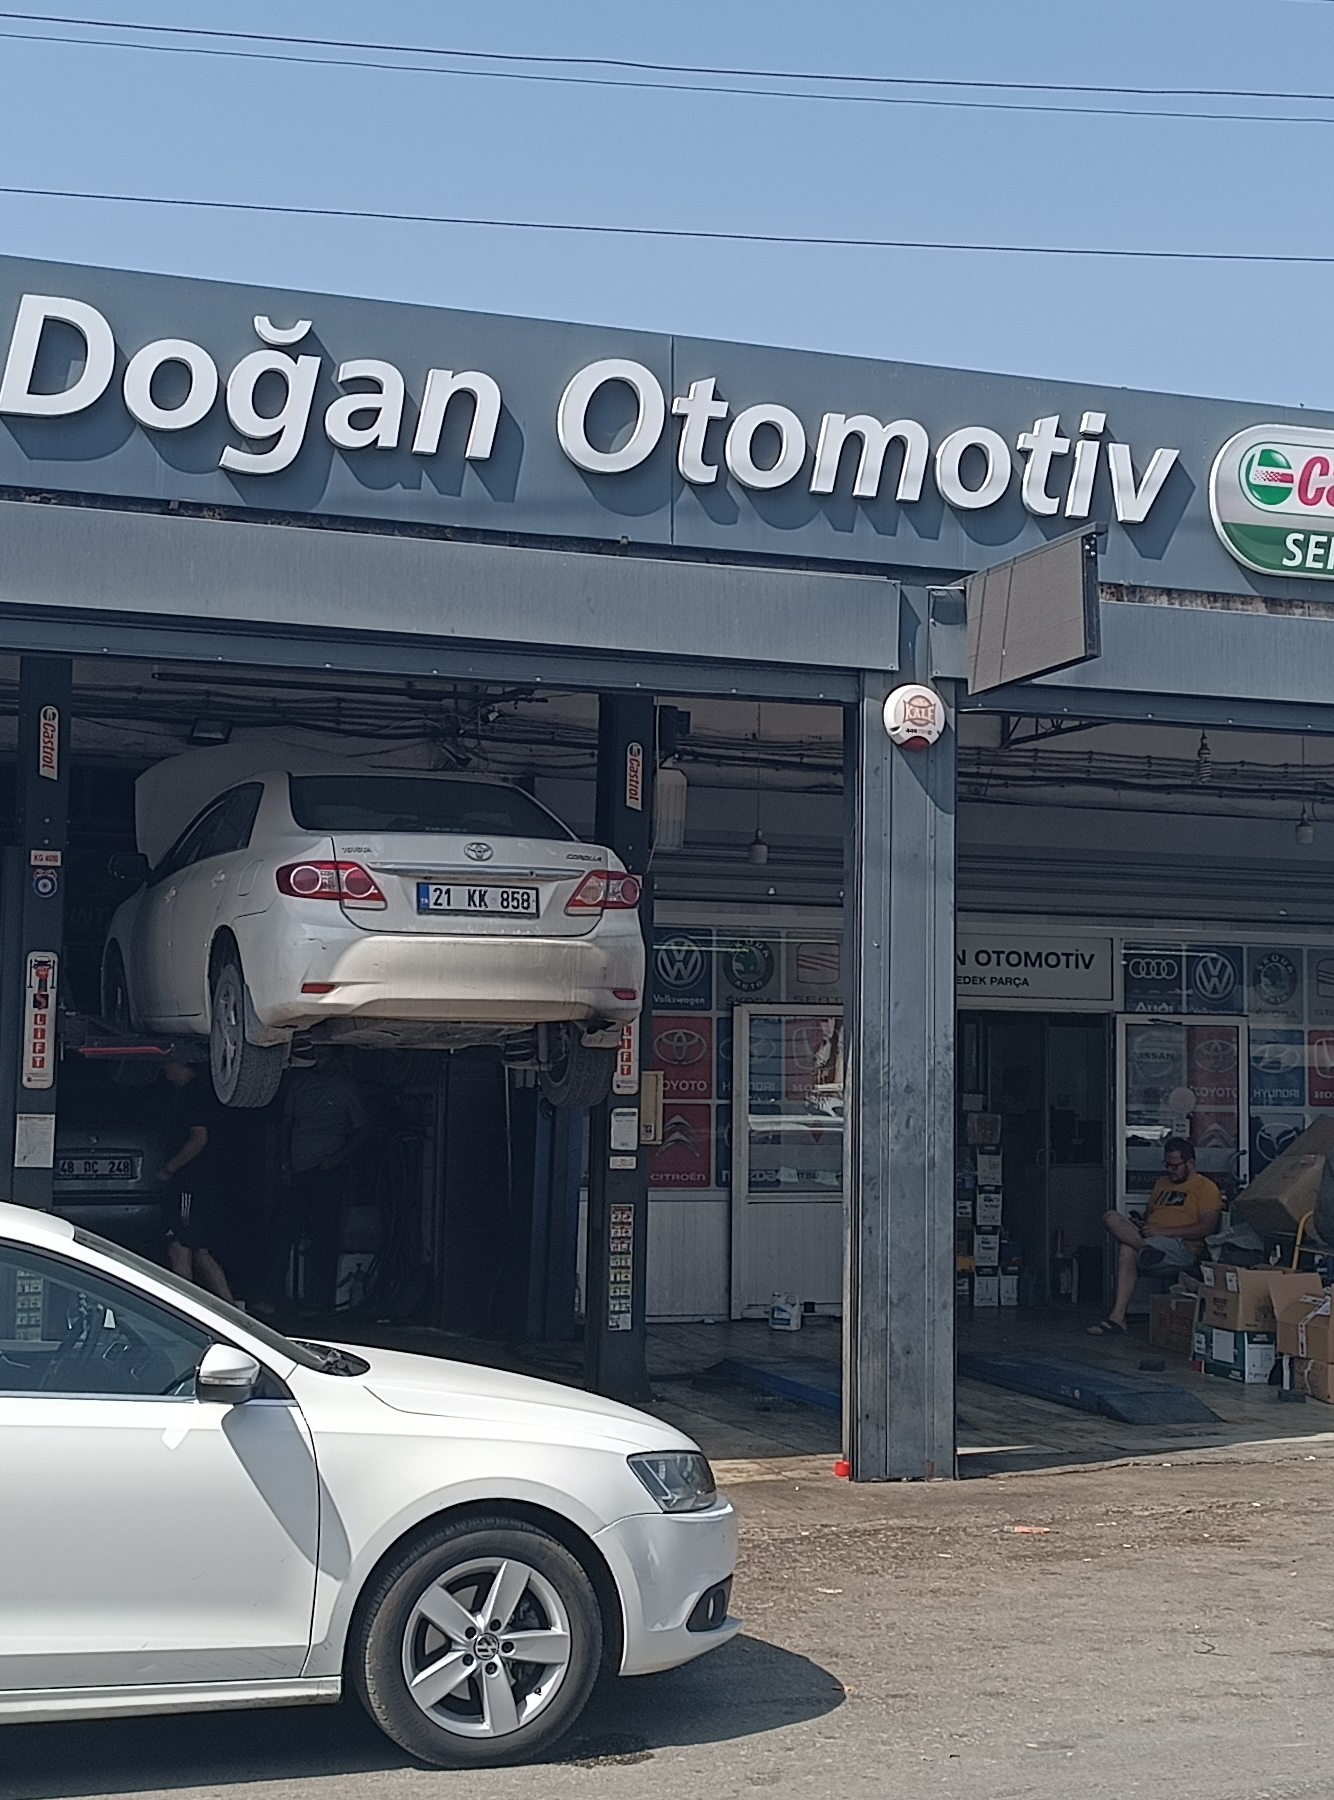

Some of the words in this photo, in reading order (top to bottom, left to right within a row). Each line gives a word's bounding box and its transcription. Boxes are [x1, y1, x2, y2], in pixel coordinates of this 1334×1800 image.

[556, 358, 1180, 524] Otomotiv
[906, 706, 935, 719] KALE
[42, 722, 57, 770] Castrol
[629, 758, 641, 801] Castrol
[33, 854, 44, 863] KG
[45, 854, 59, 864] 4000
[566, 853, 602, 863] COROLLA
[432, 887, 451, 908] 21
[467, 888, 489, 909] KK
[500, 891, 530, 911] 858
[974, 948, 1096, 970] OTOMOTİV
[957, 976, 987, 986] EDEK
[990, 976, 1030, 988] PARÇA
[653, 994, 706, 1007] Volkswagen
[1135, 1002, 1174, 1013] Audi
[662, 1080, 707, 1092] OYOTO
[1253, 1089, 1300, 1099] HYUNDAI
[60, 1160, 74, 1174] 48
[83, 1160, 99, 1174] DC
[108, 1160, 131, 1174] 248
[650, 1172, 706, 1182] CITROËN
